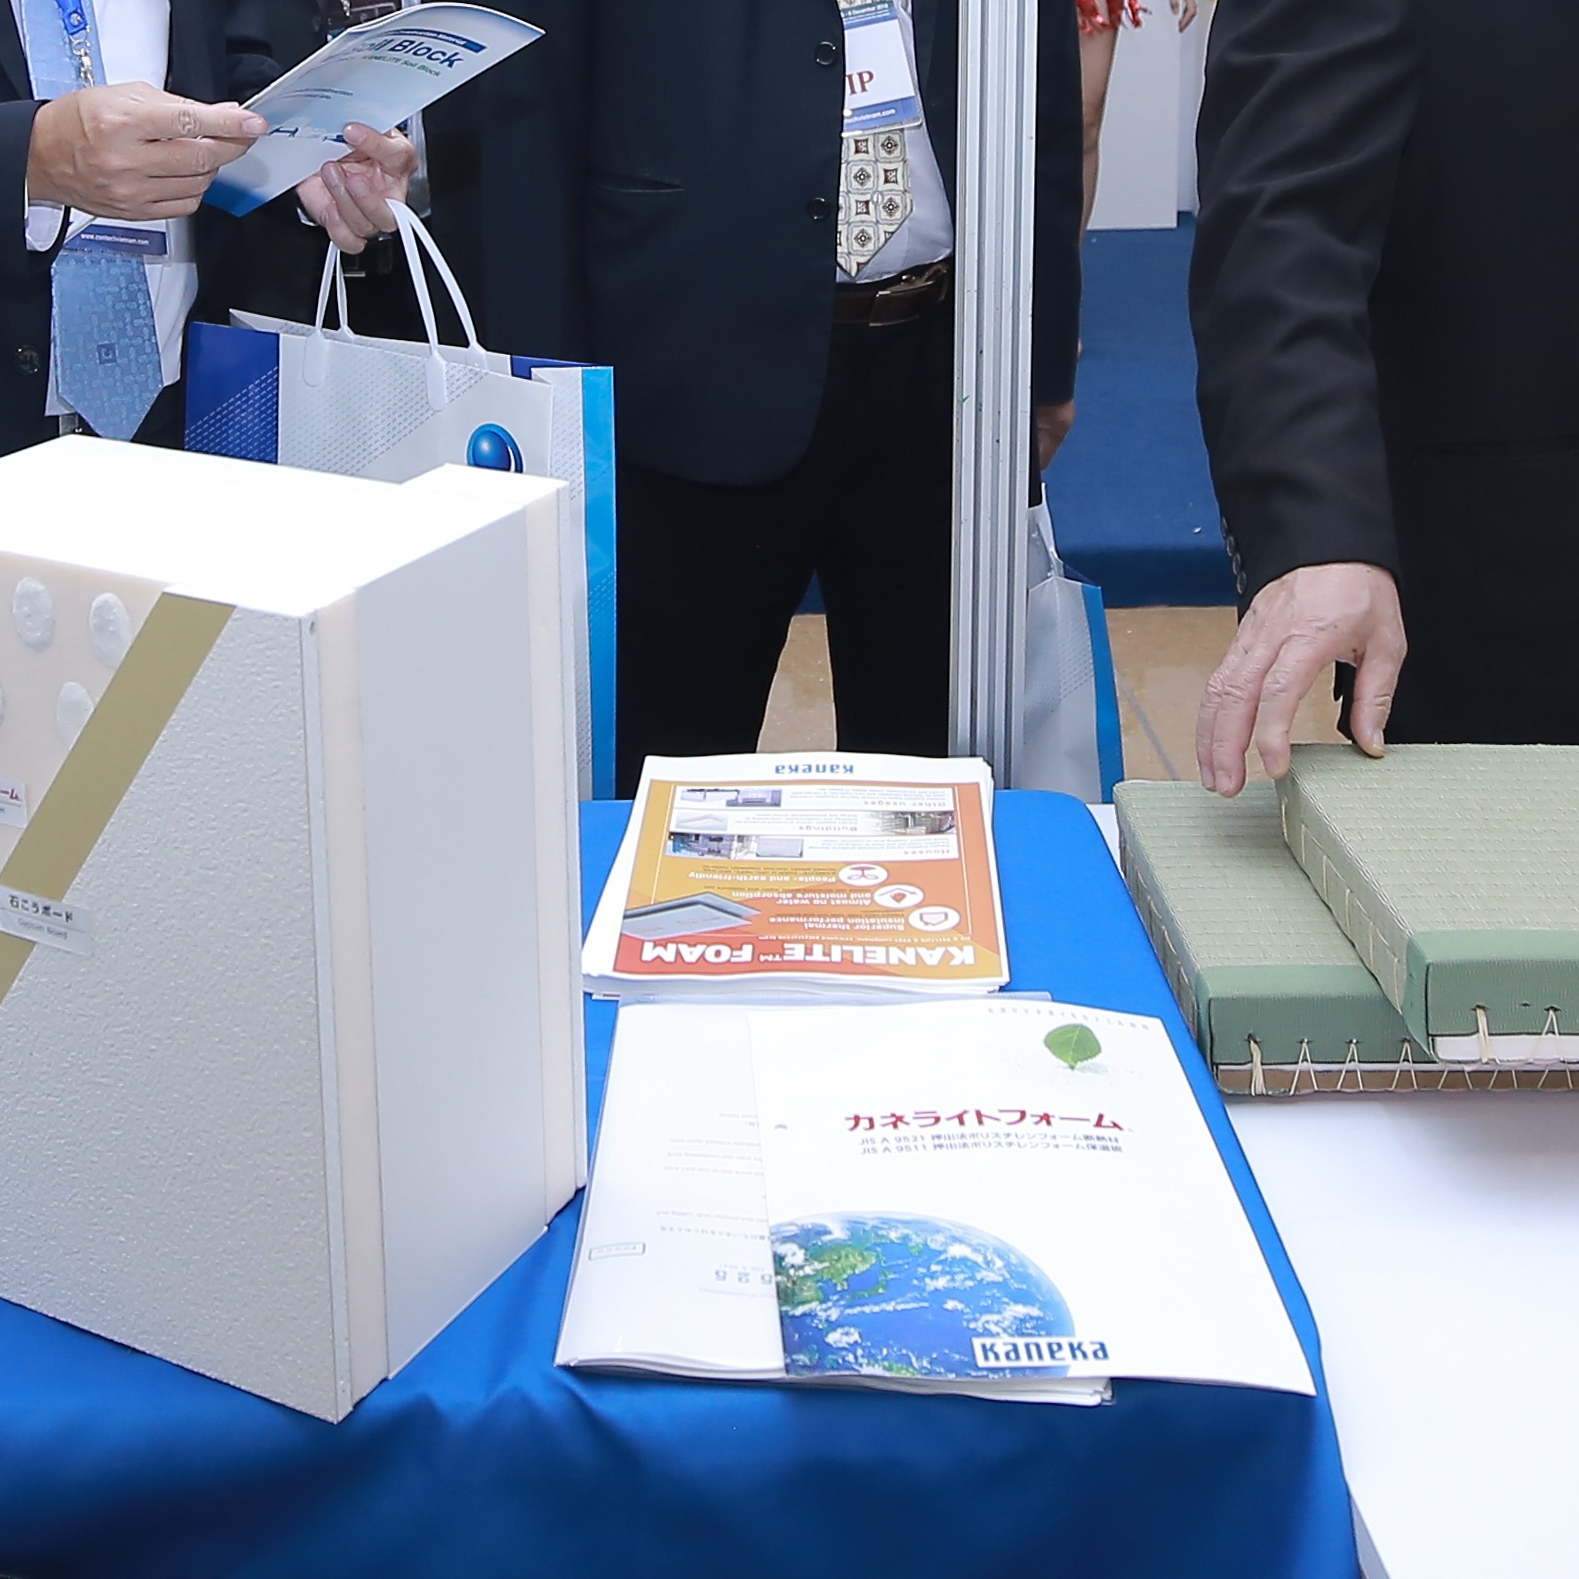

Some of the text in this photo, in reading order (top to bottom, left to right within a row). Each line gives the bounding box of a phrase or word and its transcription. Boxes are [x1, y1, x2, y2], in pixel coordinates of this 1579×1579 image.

[388, 38, 464, 69] Block
[846, 70, 875, 96] IP
[798, 825, 858, 833] Buildings
[688, 870, 768, 882] earth-friendly
[770, 874, 790, 883] and
[731, 890, 872, 900] and moisture absorption
[775, 897, 812, 906] water
[835, 897, 872, 907] Almost
[8, 894, 74, 922] 石こうボード
[768, 914, 845, 924] performance
[804, 922, 905, 932] Superior thermal
[640, 941, 754, 964] FOAM
[844, 1109, 1124, 1132] カネライトフォーム
[859, 1134, 878, 1145] JIS
[881, 1135, 892, 1144] A
[860, 1145, 878, 1154] JIS
[882, 1144, 892, 1153] A
